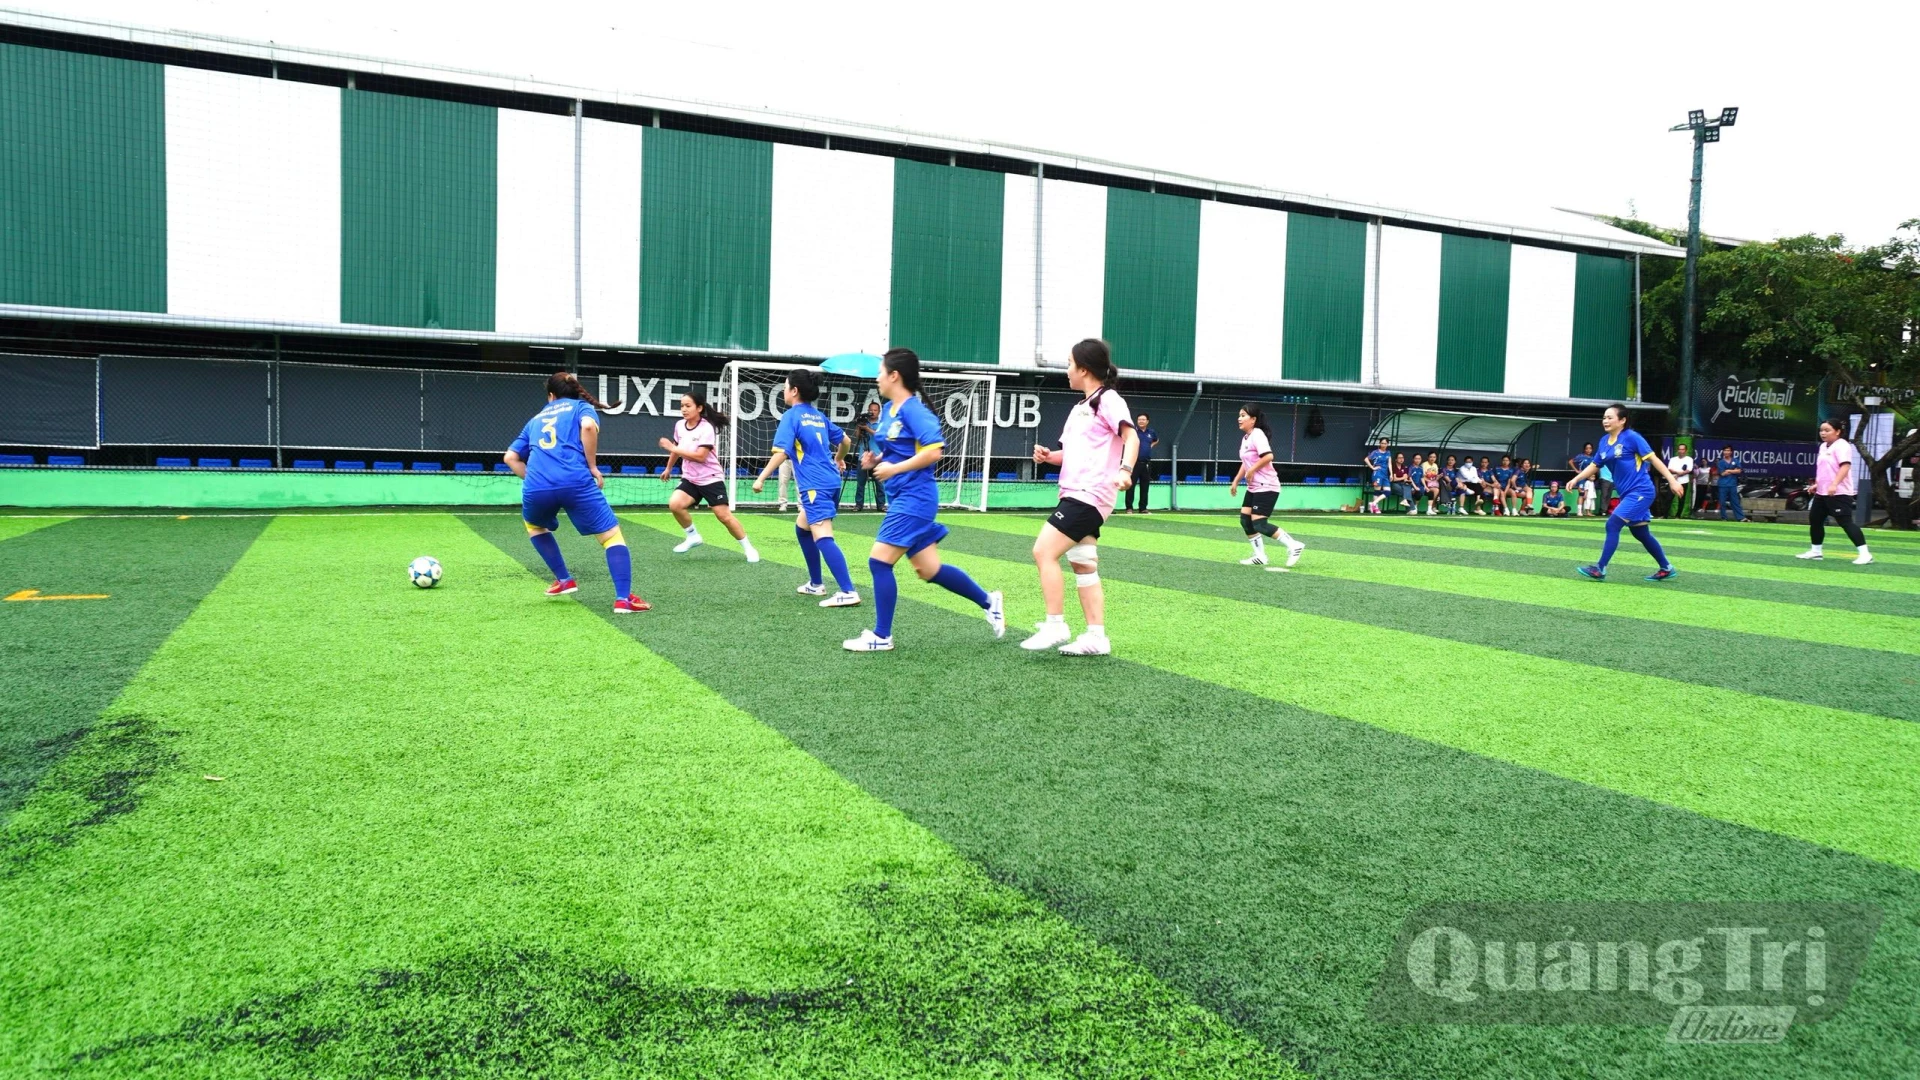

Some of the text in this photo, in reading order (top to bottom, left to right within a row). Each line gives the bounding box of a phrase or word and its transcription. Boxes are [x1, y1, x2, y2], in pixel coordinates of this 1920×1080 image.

[570, 373, 691, 417] UXE
[945, 392, 1041, 428] CLUB
[1724, 385, 1793, 406] Pickleball
[1738, 407, 1785, 420] LUXE CLUB
[539, 416, 558, 449] 3
[1733, 450, 1793, 465] PICKLEBALL
[1796, 452, 1818, 466] CLU
